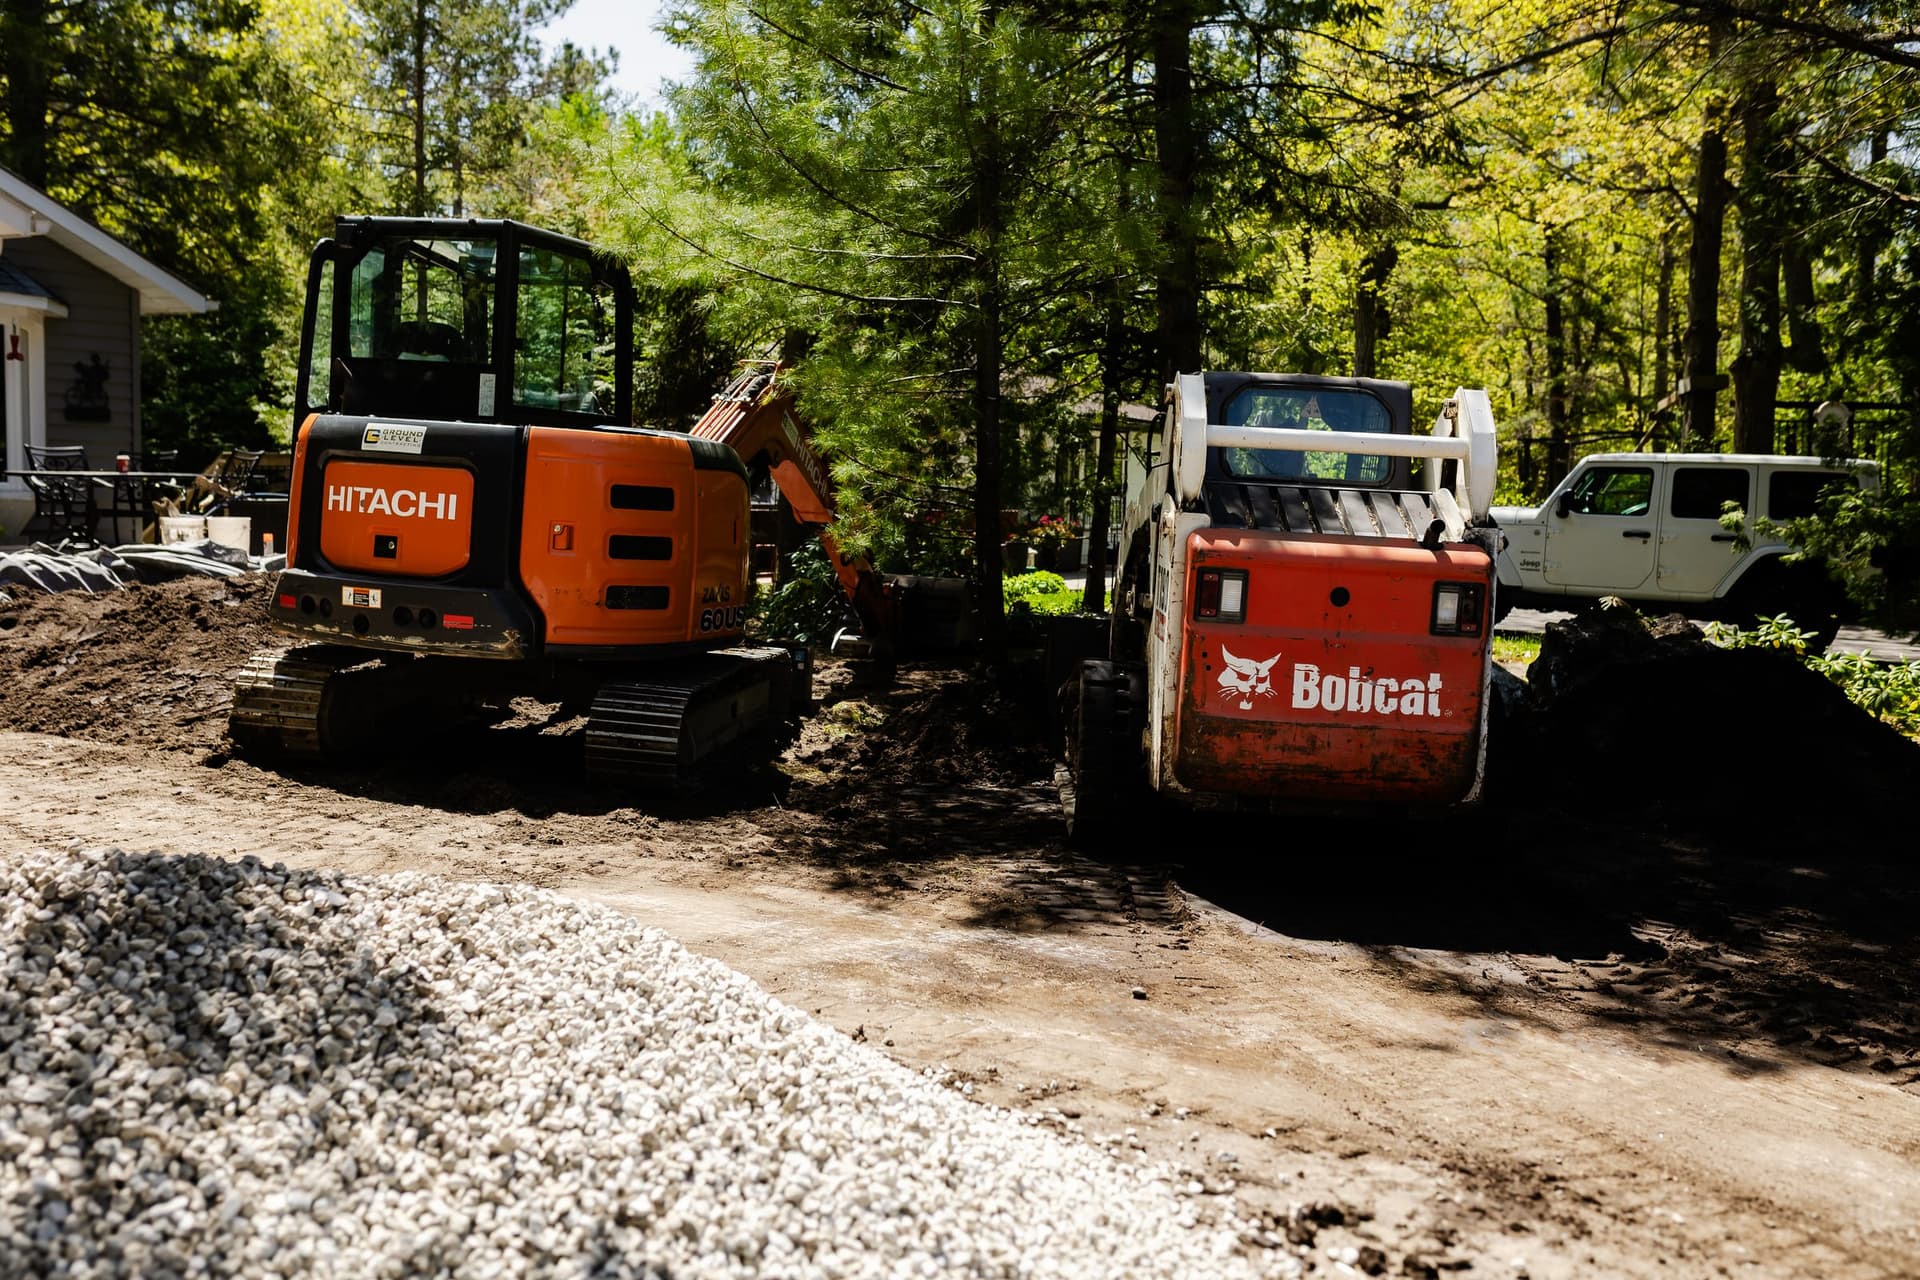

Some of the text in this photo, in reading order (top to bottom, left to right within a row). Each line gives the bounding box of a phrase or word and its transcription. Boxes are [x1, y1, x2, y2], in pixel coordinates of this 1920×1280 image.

[383, 429, 423, 438] GROUND
[383, 434, 419, 443] LEVEL
[795, 436, 828, 498] HITACHI
[327, 485, 457, 520] HITACHI
[1519, 558, 1541, 568] Jeep
[1292, 663, 1442, 717] Bobcat
